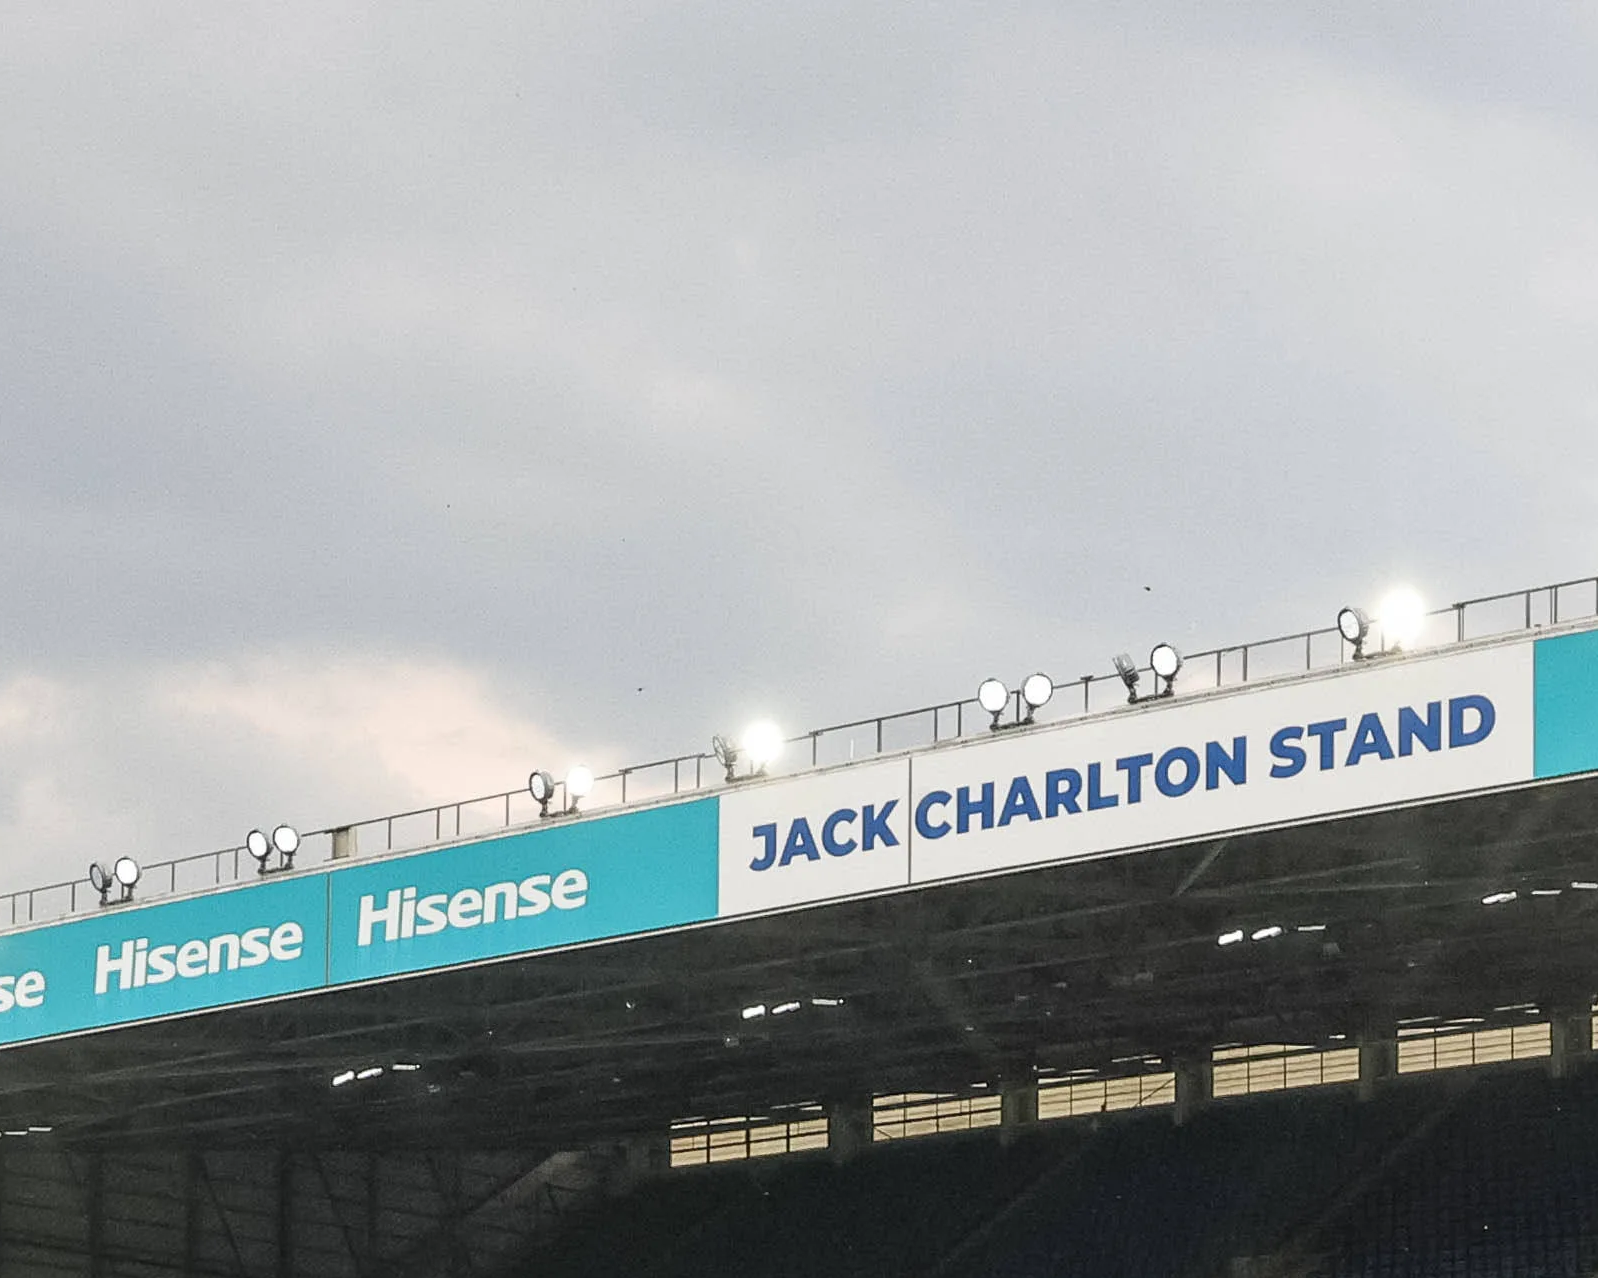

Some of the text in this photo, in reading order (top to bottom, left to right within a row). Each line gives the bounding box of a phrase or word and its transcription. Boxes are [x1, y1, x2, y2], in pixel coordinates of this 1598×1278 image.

[753, 697, 1494, 869] JACK CHARLTON STAND
[358, 870, 587, 946] Hisense
[95, 923, 302, 994] Hisense
